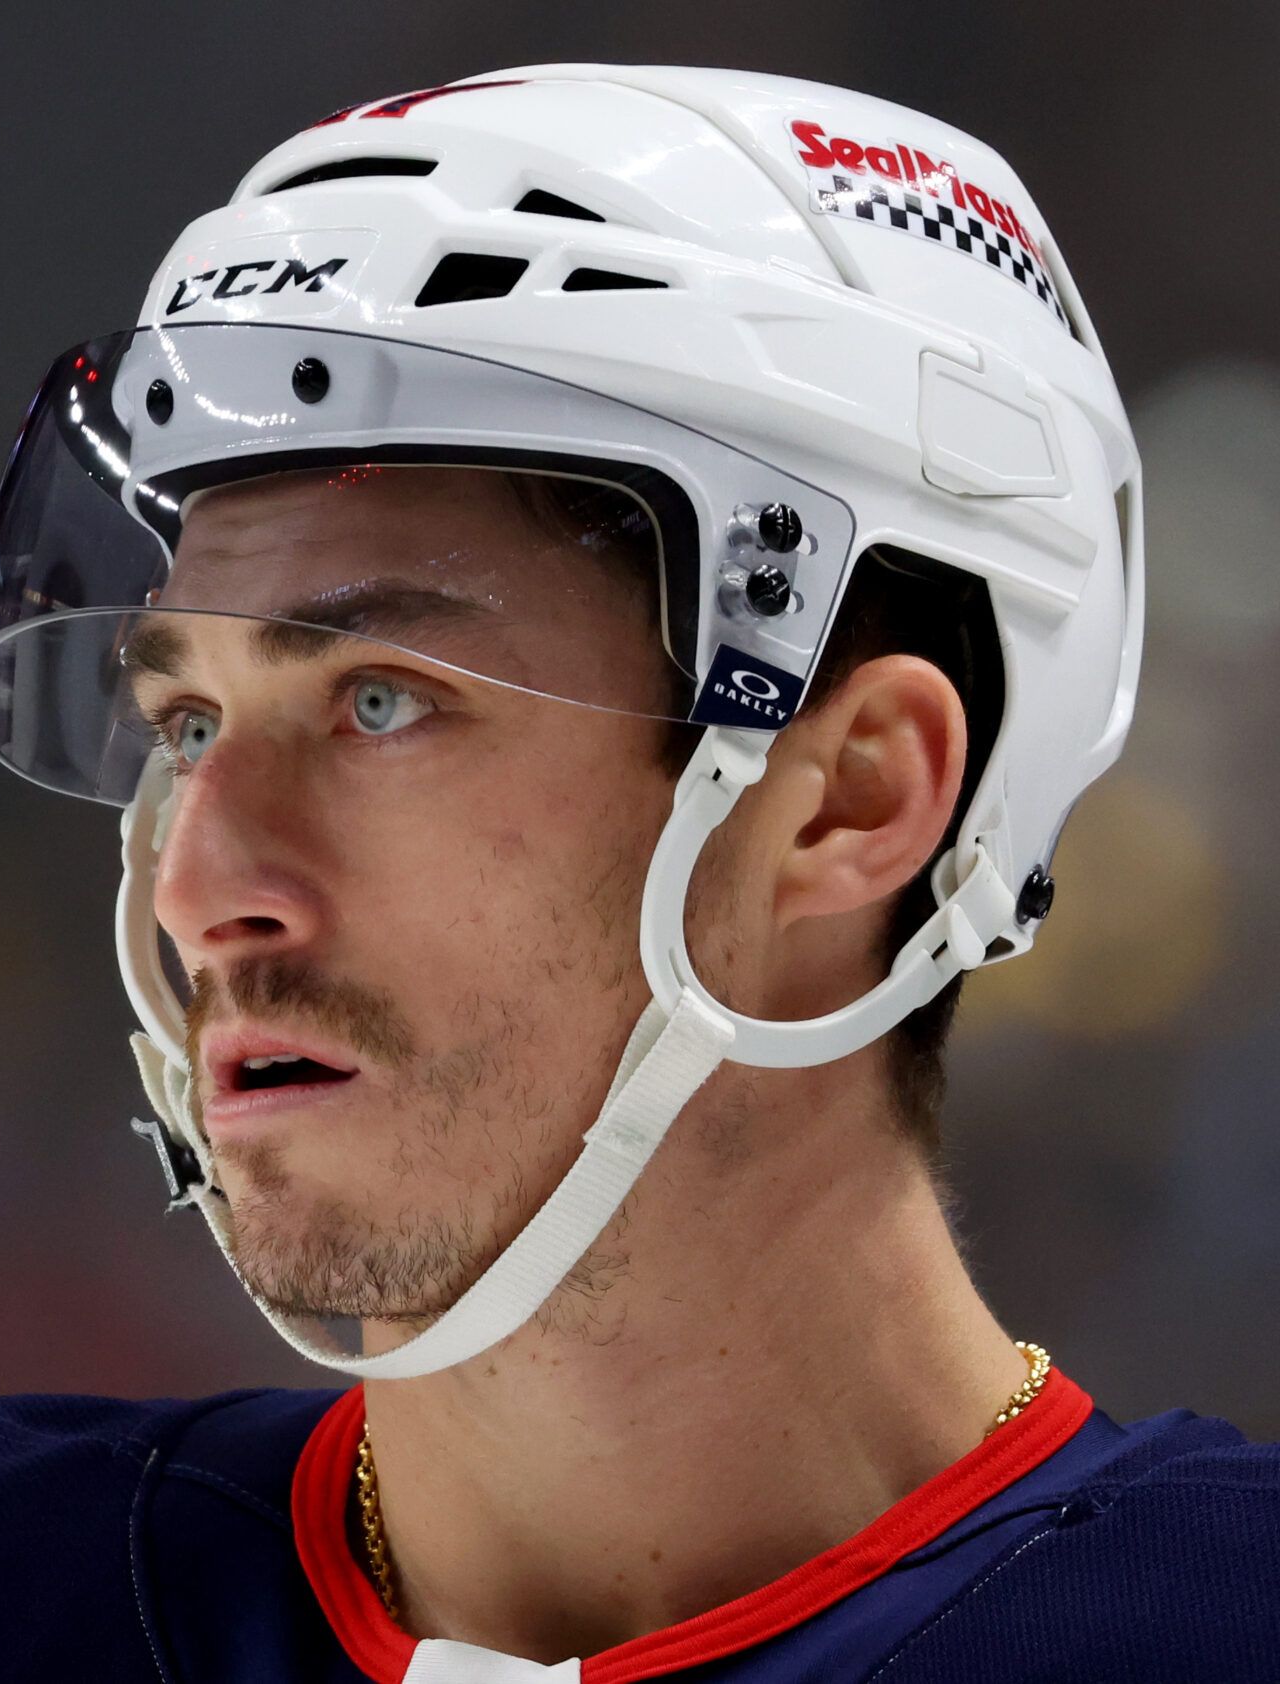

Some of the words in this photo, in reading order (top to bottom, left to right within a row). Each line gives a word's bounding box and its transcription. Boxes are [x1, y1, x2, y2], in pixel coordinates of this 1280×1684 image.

[791, 119, 1044, 264] SealMast
[166, 258, 349, 316] CCM
[714, 682, 787, 721] OAKLEY
